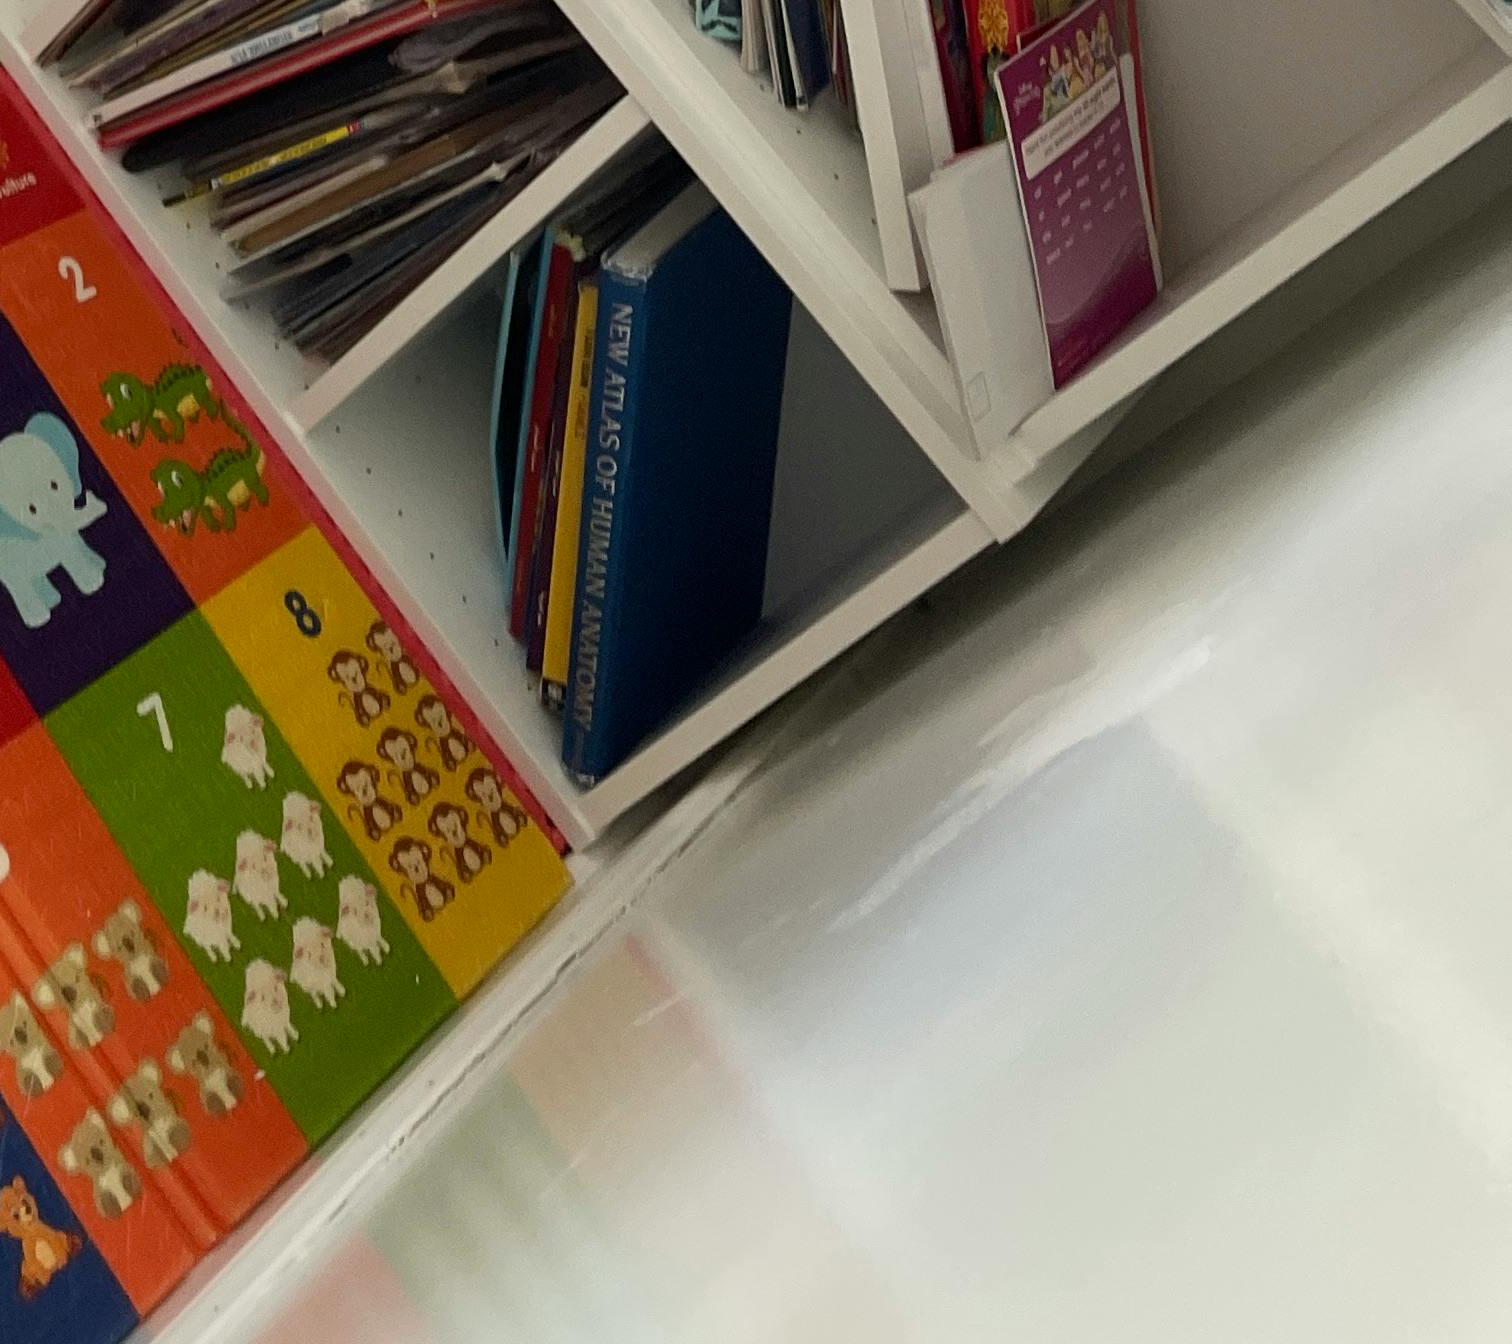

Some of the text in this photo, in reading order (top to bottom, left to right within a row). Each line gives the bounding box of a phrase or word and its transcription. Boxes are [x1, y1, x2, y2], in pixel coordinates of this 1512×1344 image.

[57, 255, 97, 304] 2
[570, 303, 631, 730] NEW ATLAS OF HUMAN ANATOMY
[283, 589, 323, 639] 8
[135, 691, 176, 753] 7
